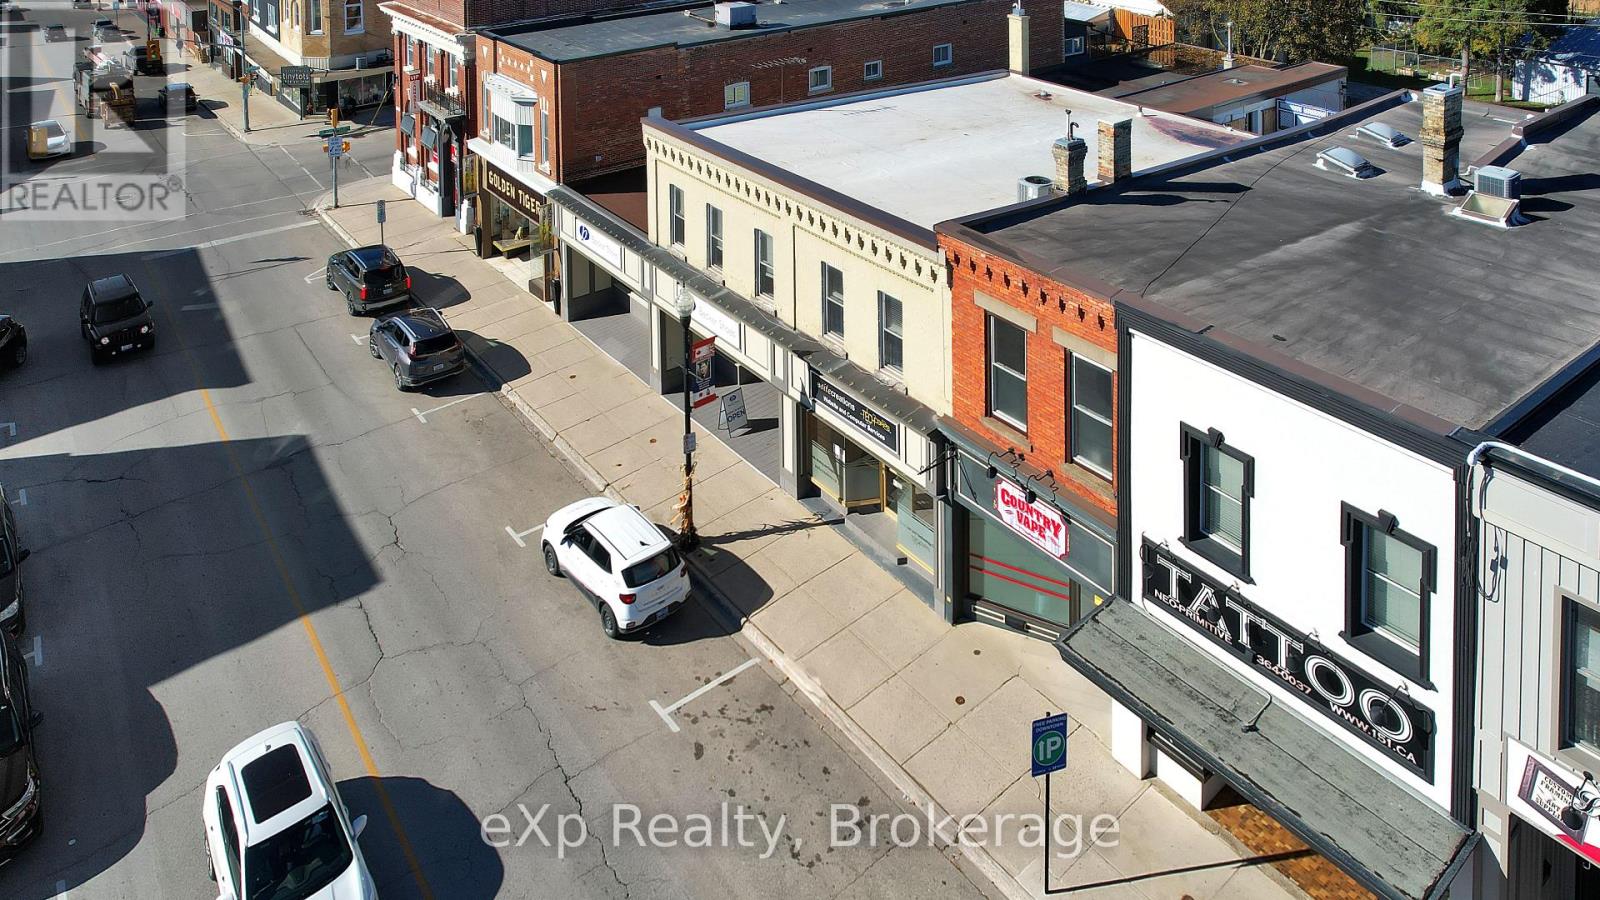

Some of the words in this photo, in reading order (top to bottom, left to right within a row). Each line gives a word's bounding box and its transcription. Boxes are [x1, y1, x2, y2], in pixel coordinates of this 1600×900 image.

[282, 72, 309, 80] tinytots
[488, 170, 516, 200] GOLDEN
[518, 190, 541, 215] TIGER
[727, 408, 747, 423] OPEN
[1016, 510, 1046, 541] VAPE
[1154, 588, 1233, 645] NEO-PRIMITIVE
[1157, 554, 1413, 744] TATTOO
[1256, 654, 1312, 695] 364-0037
[1036, 722, 1064, 733] DOWNTOWN
[1046, 715, 1066, 724] PARKING
[1329, 700, 1417, 765] WWW.151.CA
[1046, 736, 1062, 759] P
[1544, 776, 1573, 800] CUSTOM
[1535, 796, 1561, 819] SUPPLI
[1546, 799, 1561, 812] ART
